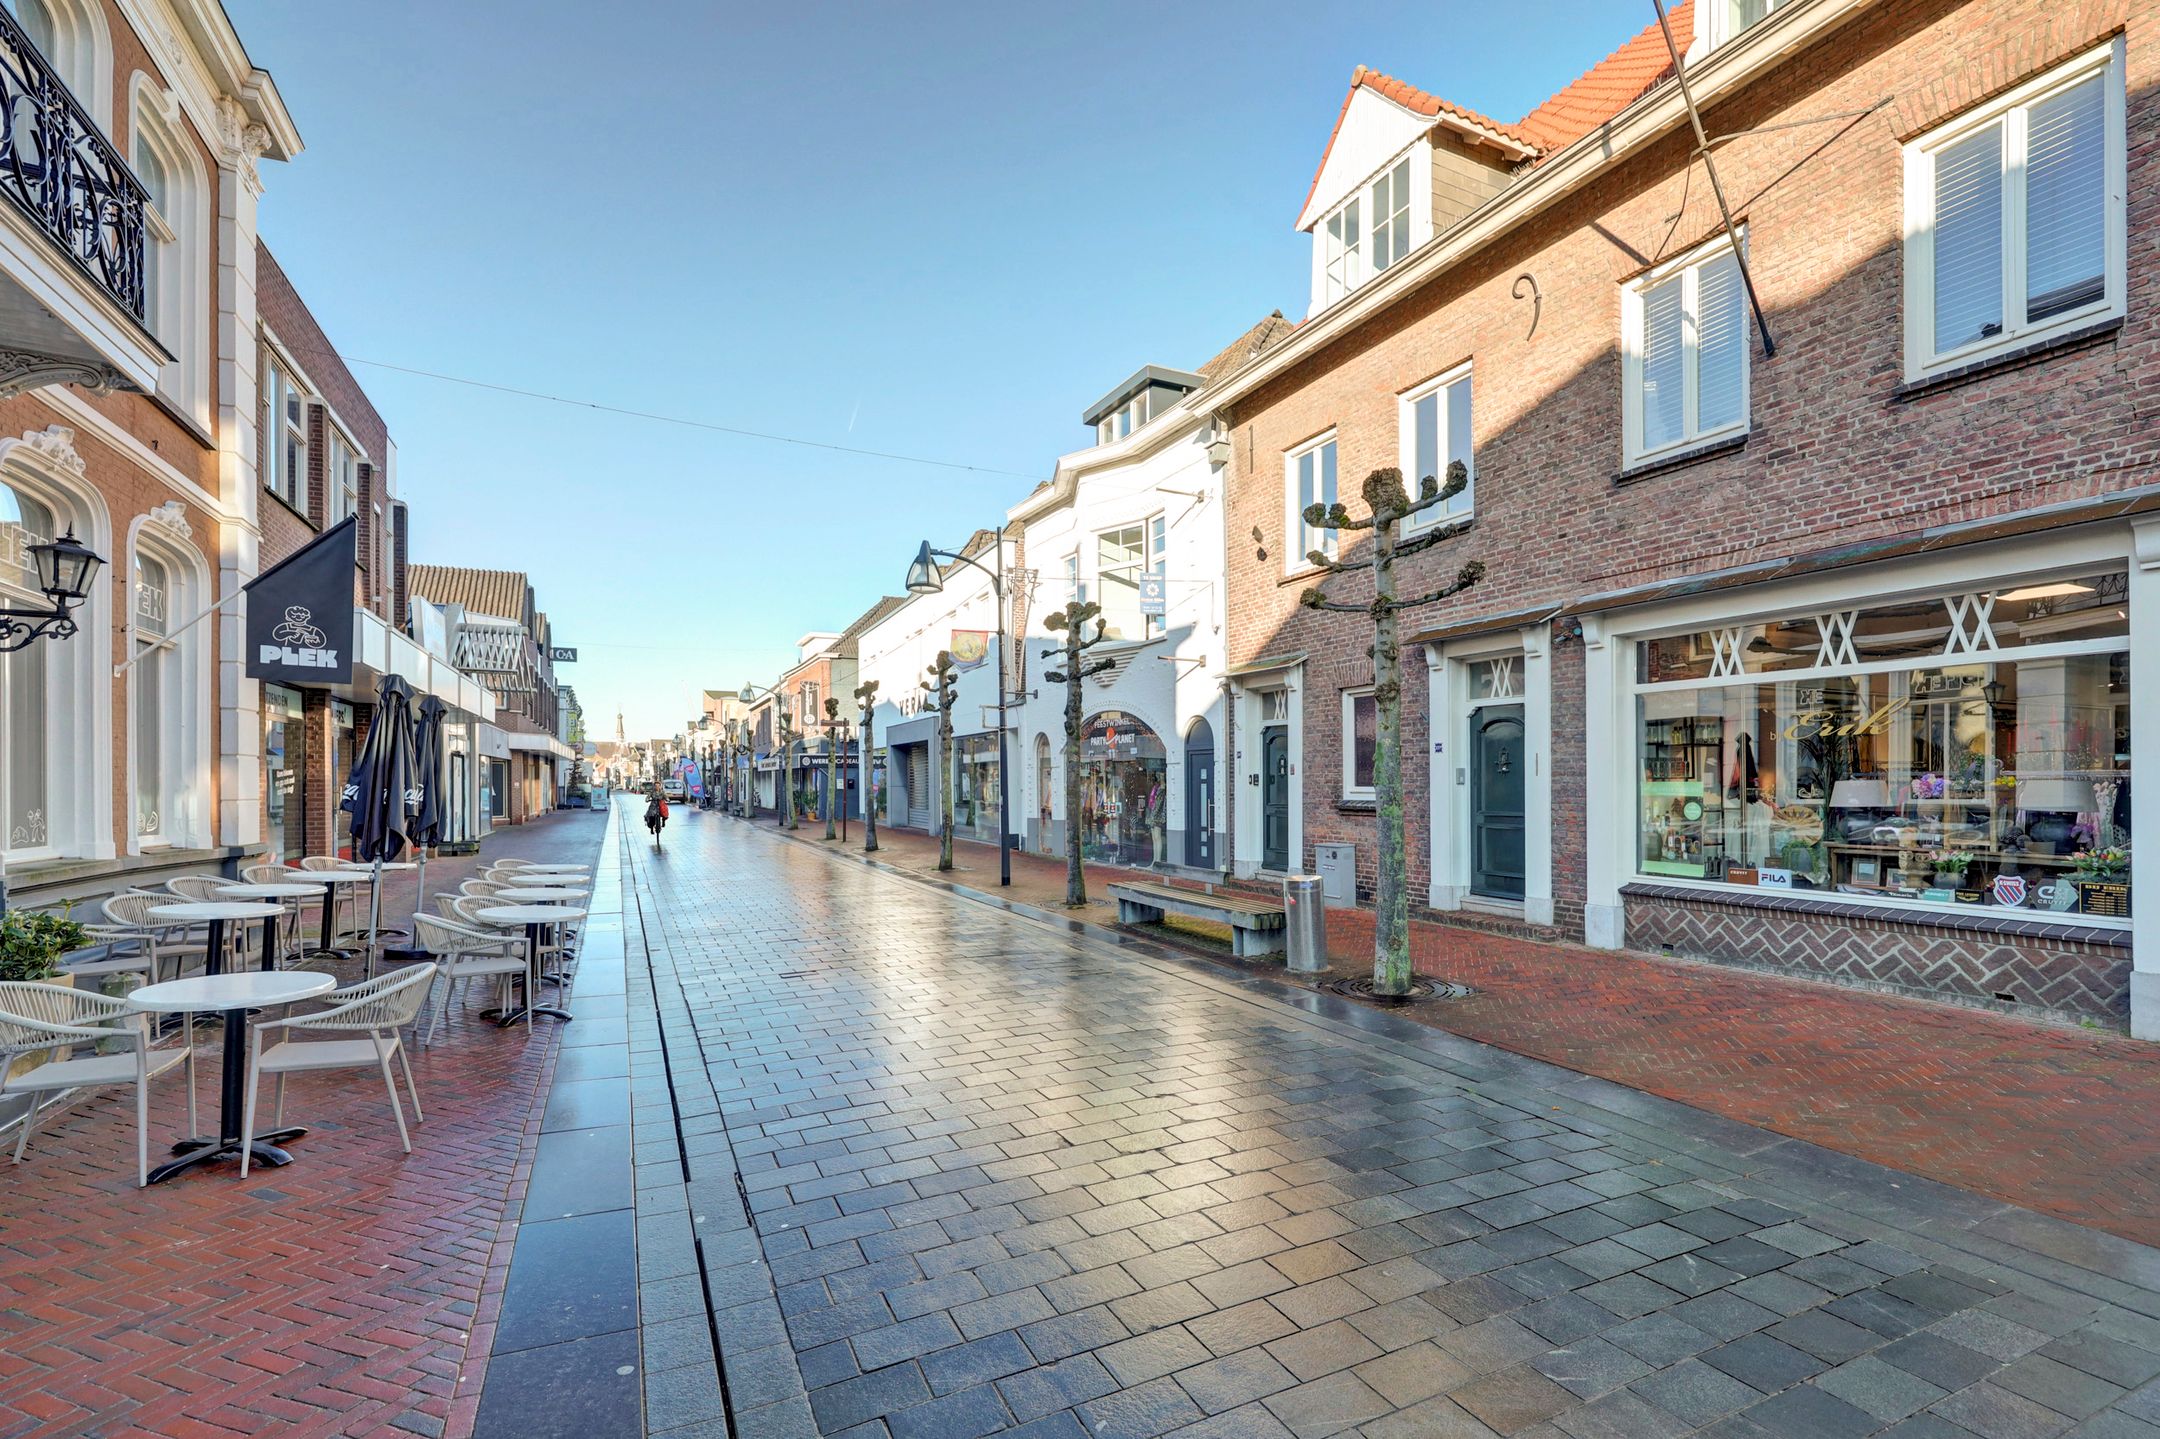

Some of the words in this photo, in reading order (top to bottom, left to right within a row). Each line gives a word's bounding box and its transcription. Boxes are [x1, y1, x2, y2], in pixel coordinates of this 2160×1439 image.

[260, 644, 338, 668] PLEK
[1784, 696, 1910, 740] Erik
[1090, 736, 1107, 746] PARTY
[1114, 733, 1135, 744] PLANET
[1762, 873, 1786, 883] FILA
